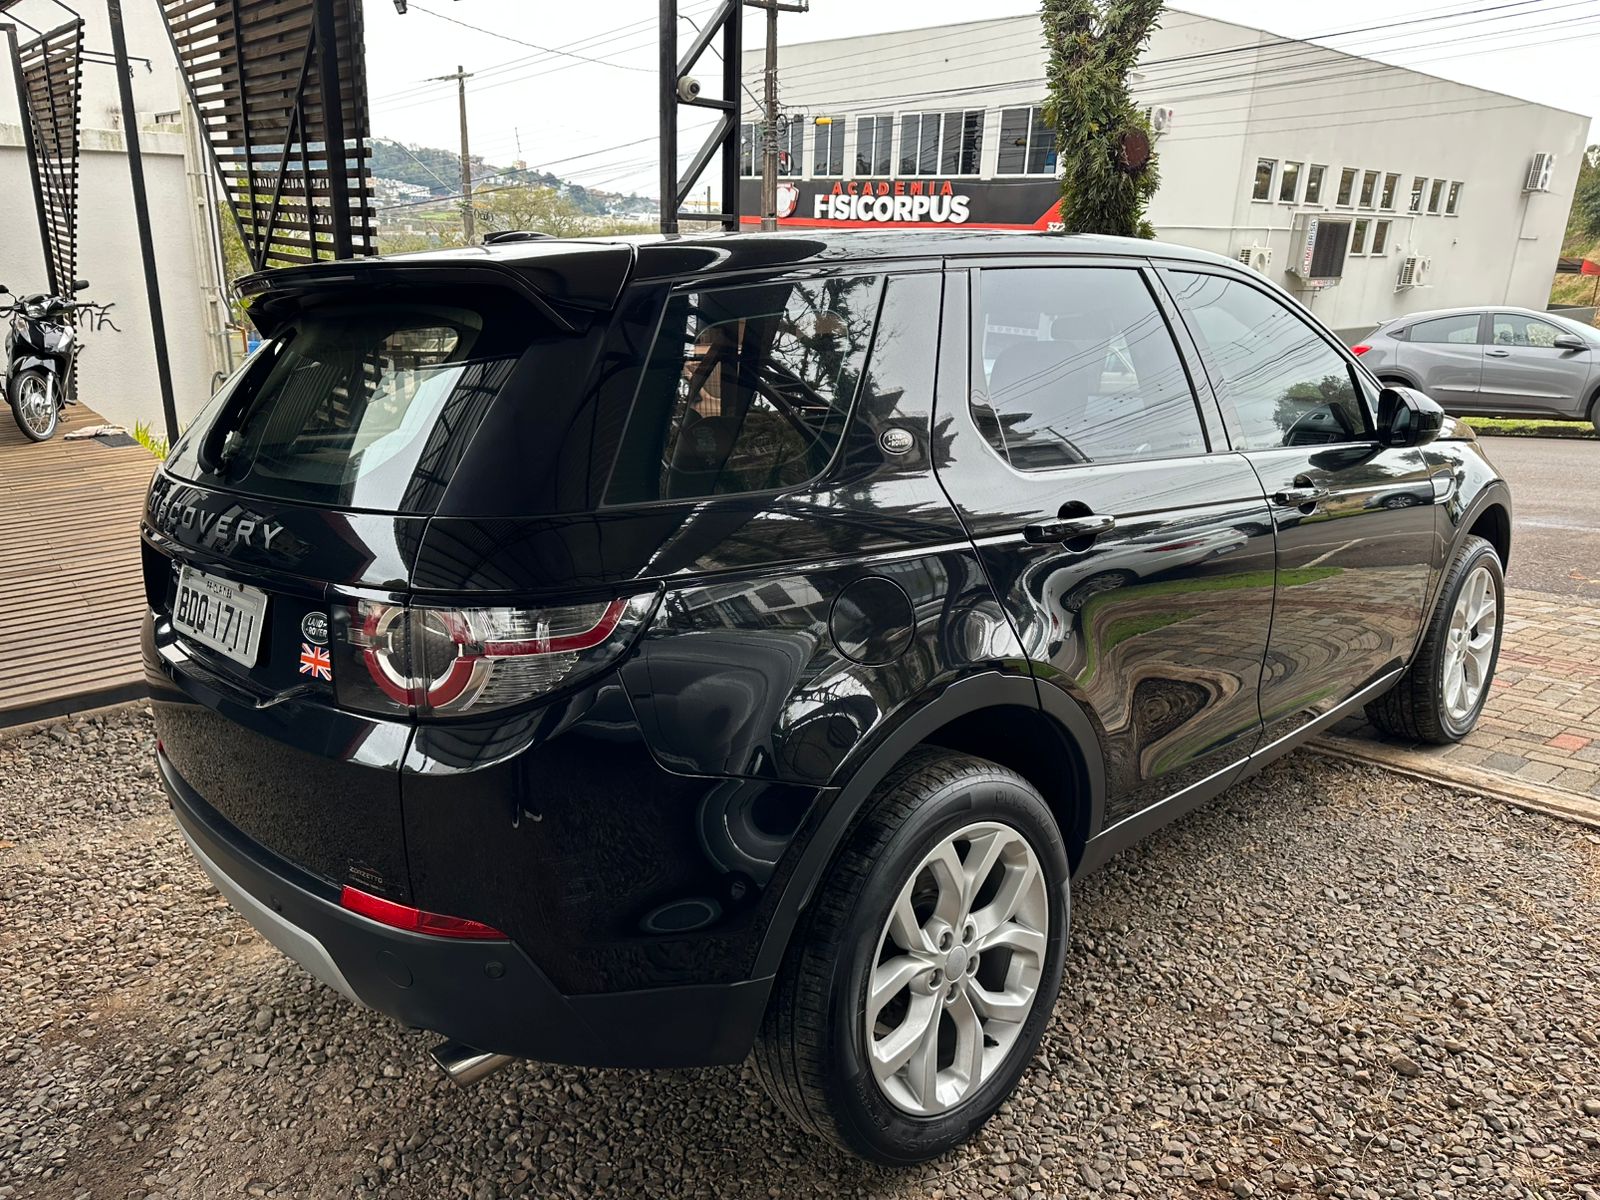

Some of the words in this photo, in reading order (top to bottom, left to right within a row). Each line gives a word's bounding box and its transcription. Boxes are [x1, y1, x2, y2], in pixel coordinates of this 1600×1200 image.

[832, 181, 953, 195] ACADEMIA
[814, 194, 970, 224] FISICORPUS
[307, 617, 324, 628] LAND
[308, 626, 328, 638] ROVER
